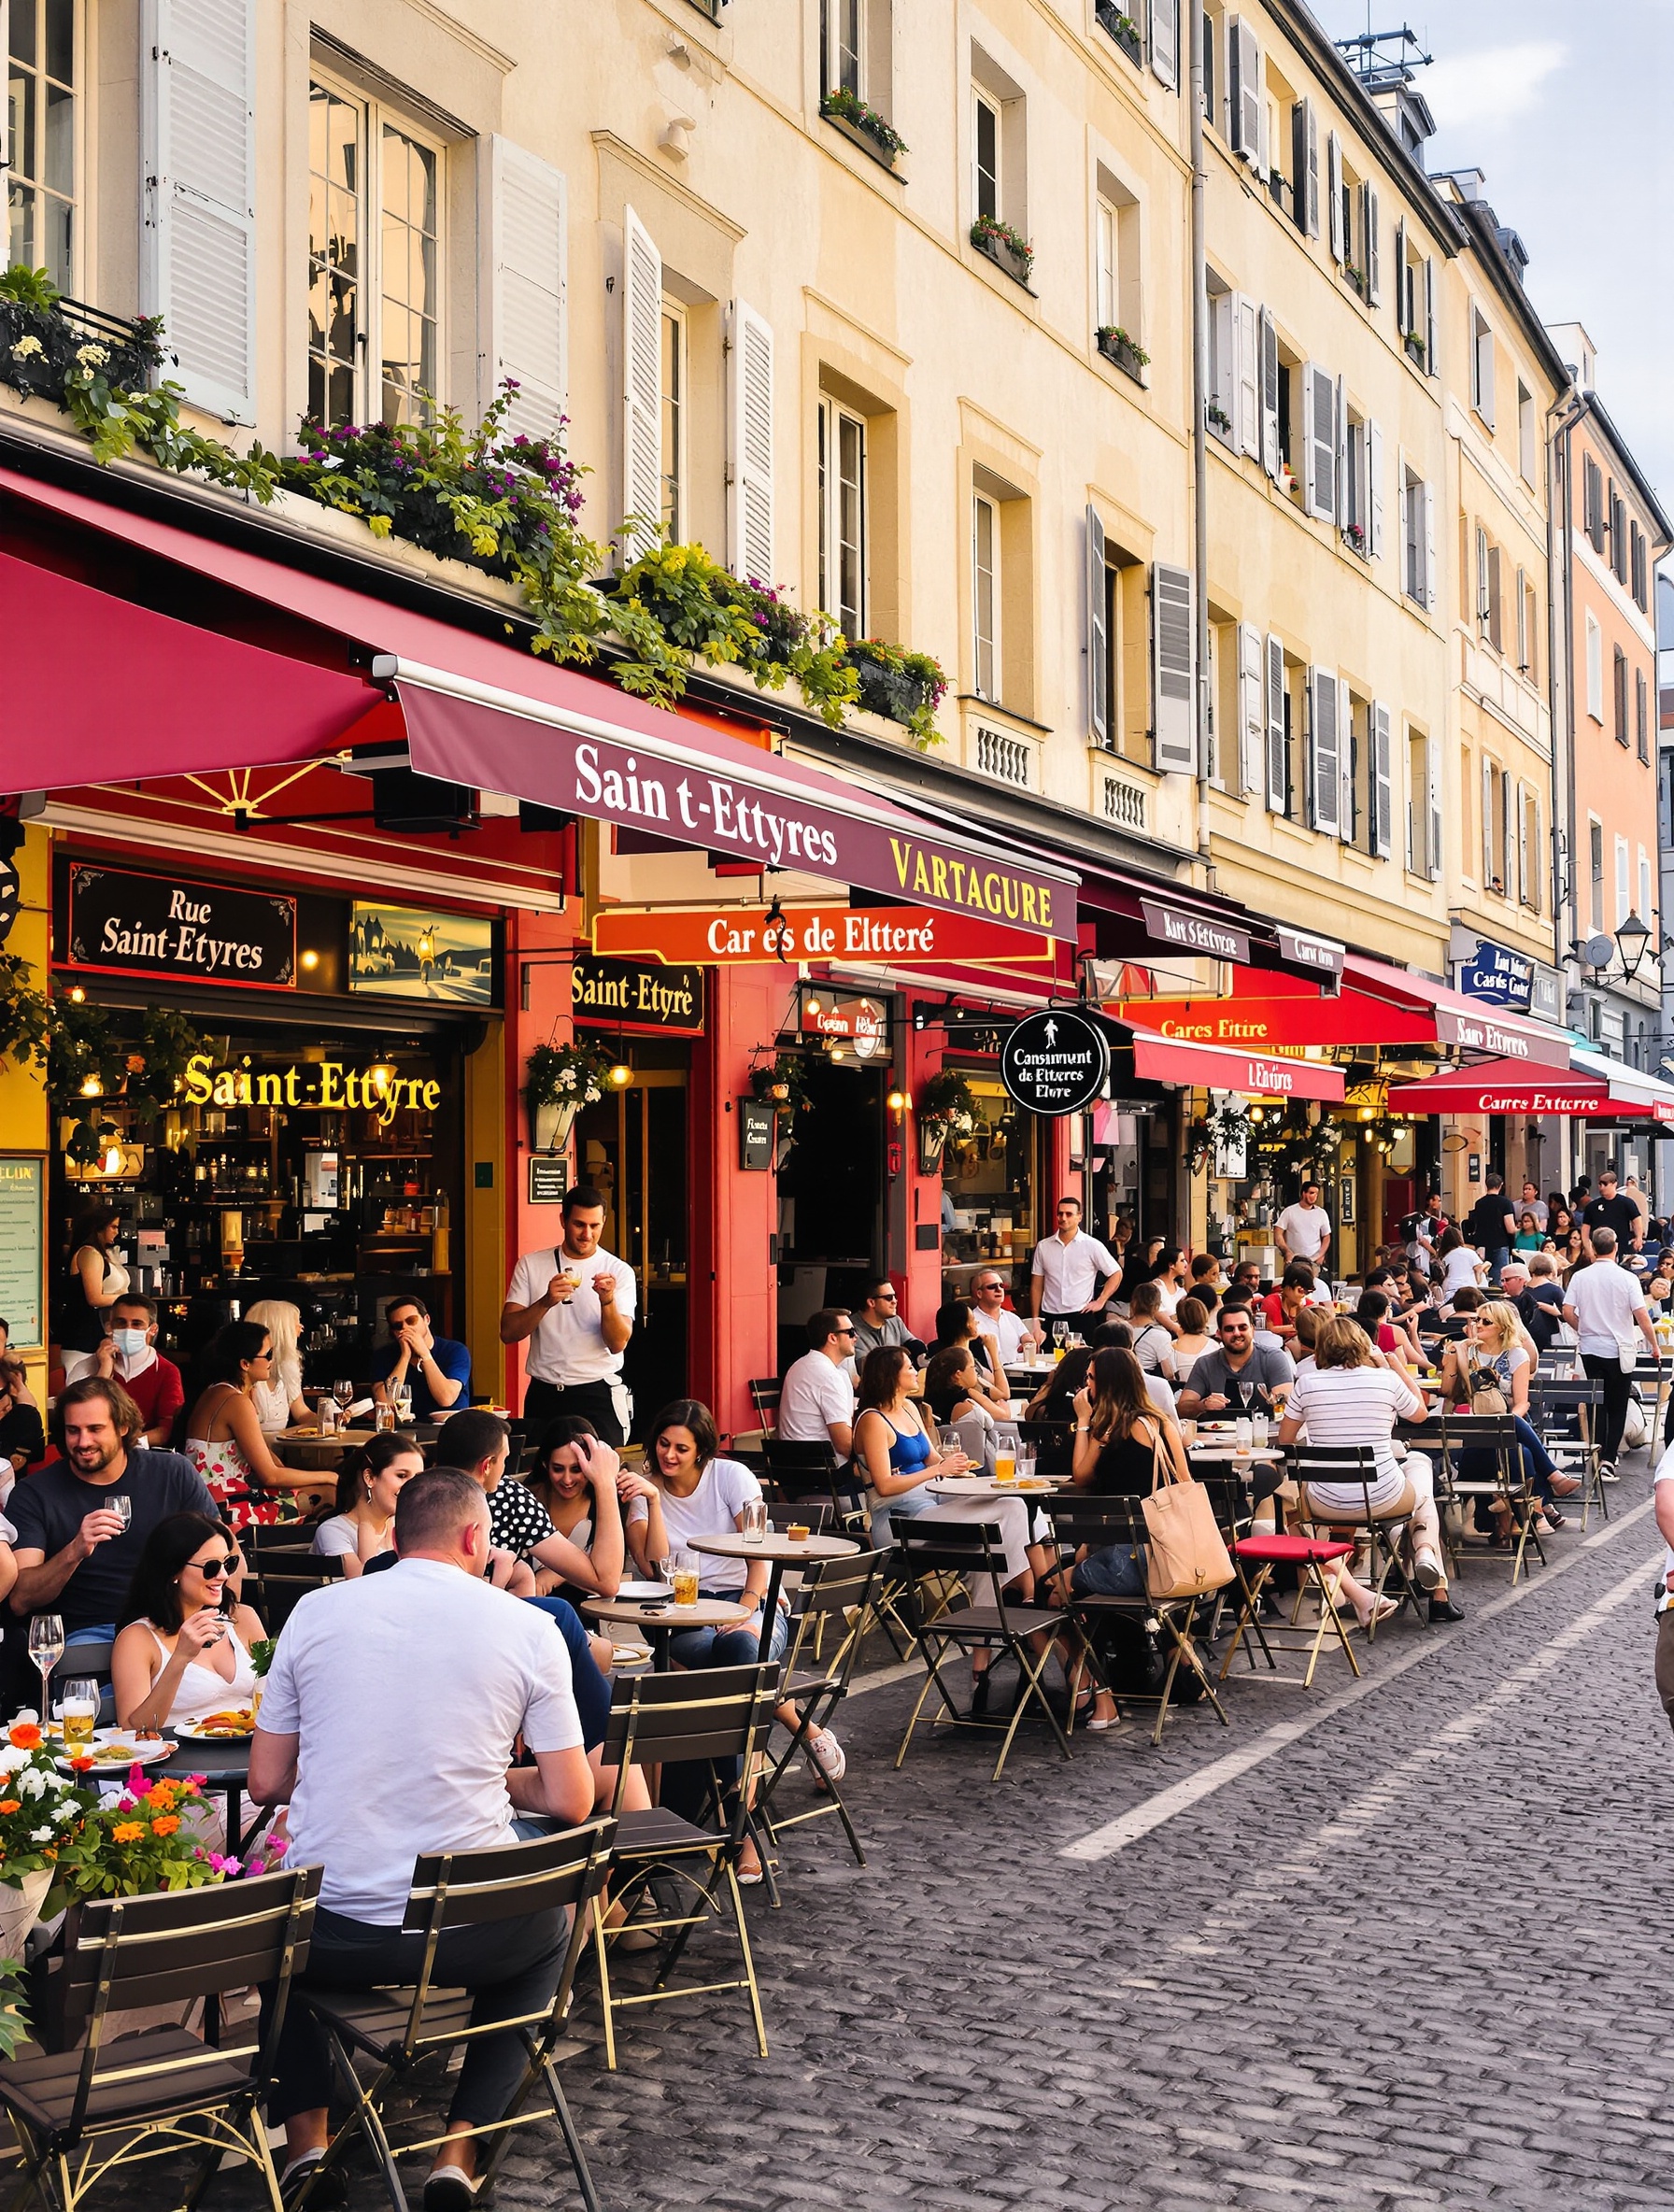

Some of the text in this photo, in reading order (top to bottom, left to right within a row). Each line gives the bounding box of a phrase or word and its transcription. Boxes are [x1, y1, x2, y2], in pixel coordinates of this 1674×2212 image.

[889, 837, 1053, 928] VARTAGURE
[168, 889, 212, 924] Rue
[100, 916, 263, 972] Saint-Etyres
[803, 916, 835, 952] de
